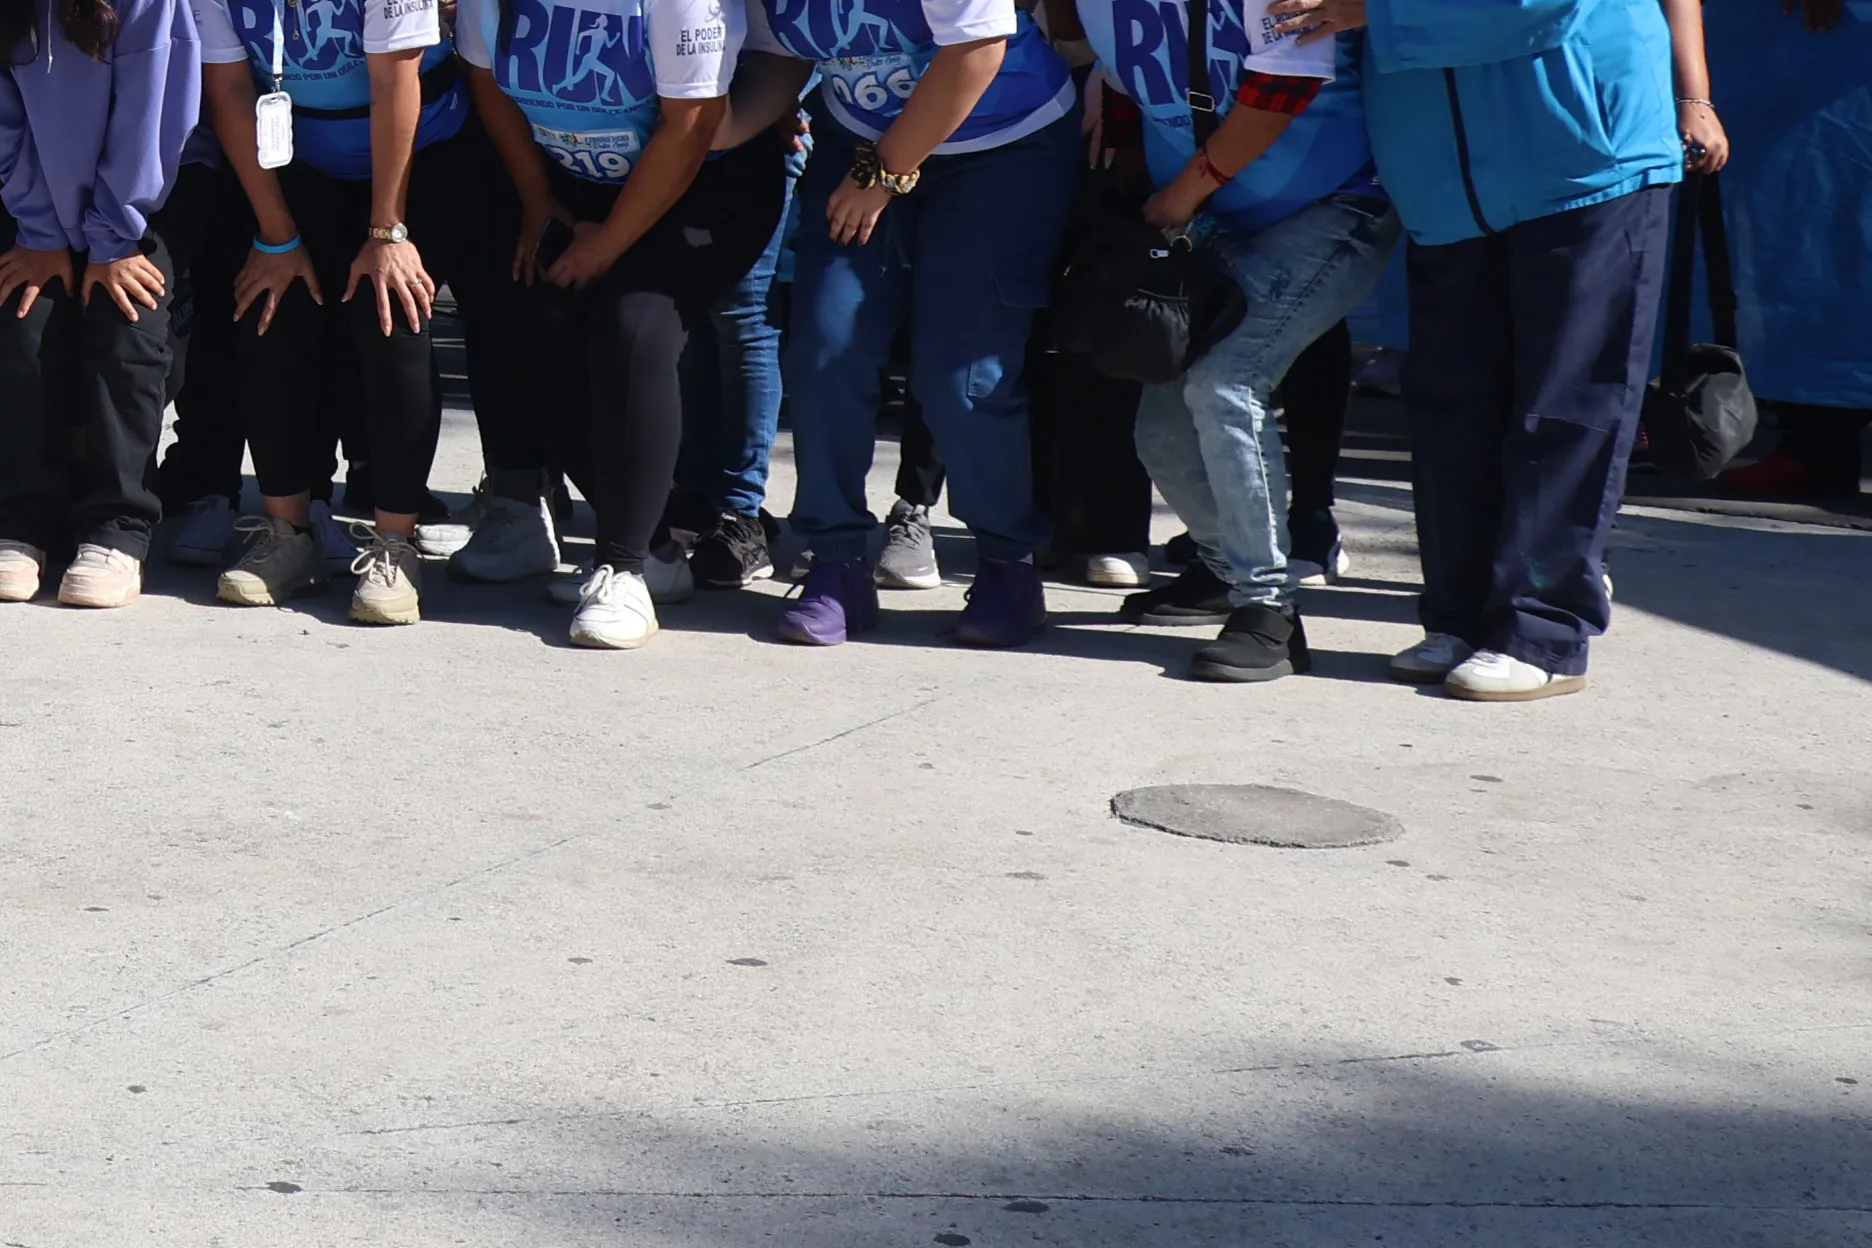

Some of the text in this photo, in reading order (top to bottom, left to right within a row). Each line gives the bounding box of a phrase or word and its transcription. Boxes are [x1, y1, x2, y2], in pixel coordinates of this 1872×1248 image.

[383, 6, 394, 19] DE
[680, 25, 722, 42] EL PODER
[676, 43, 686, 56] DE
